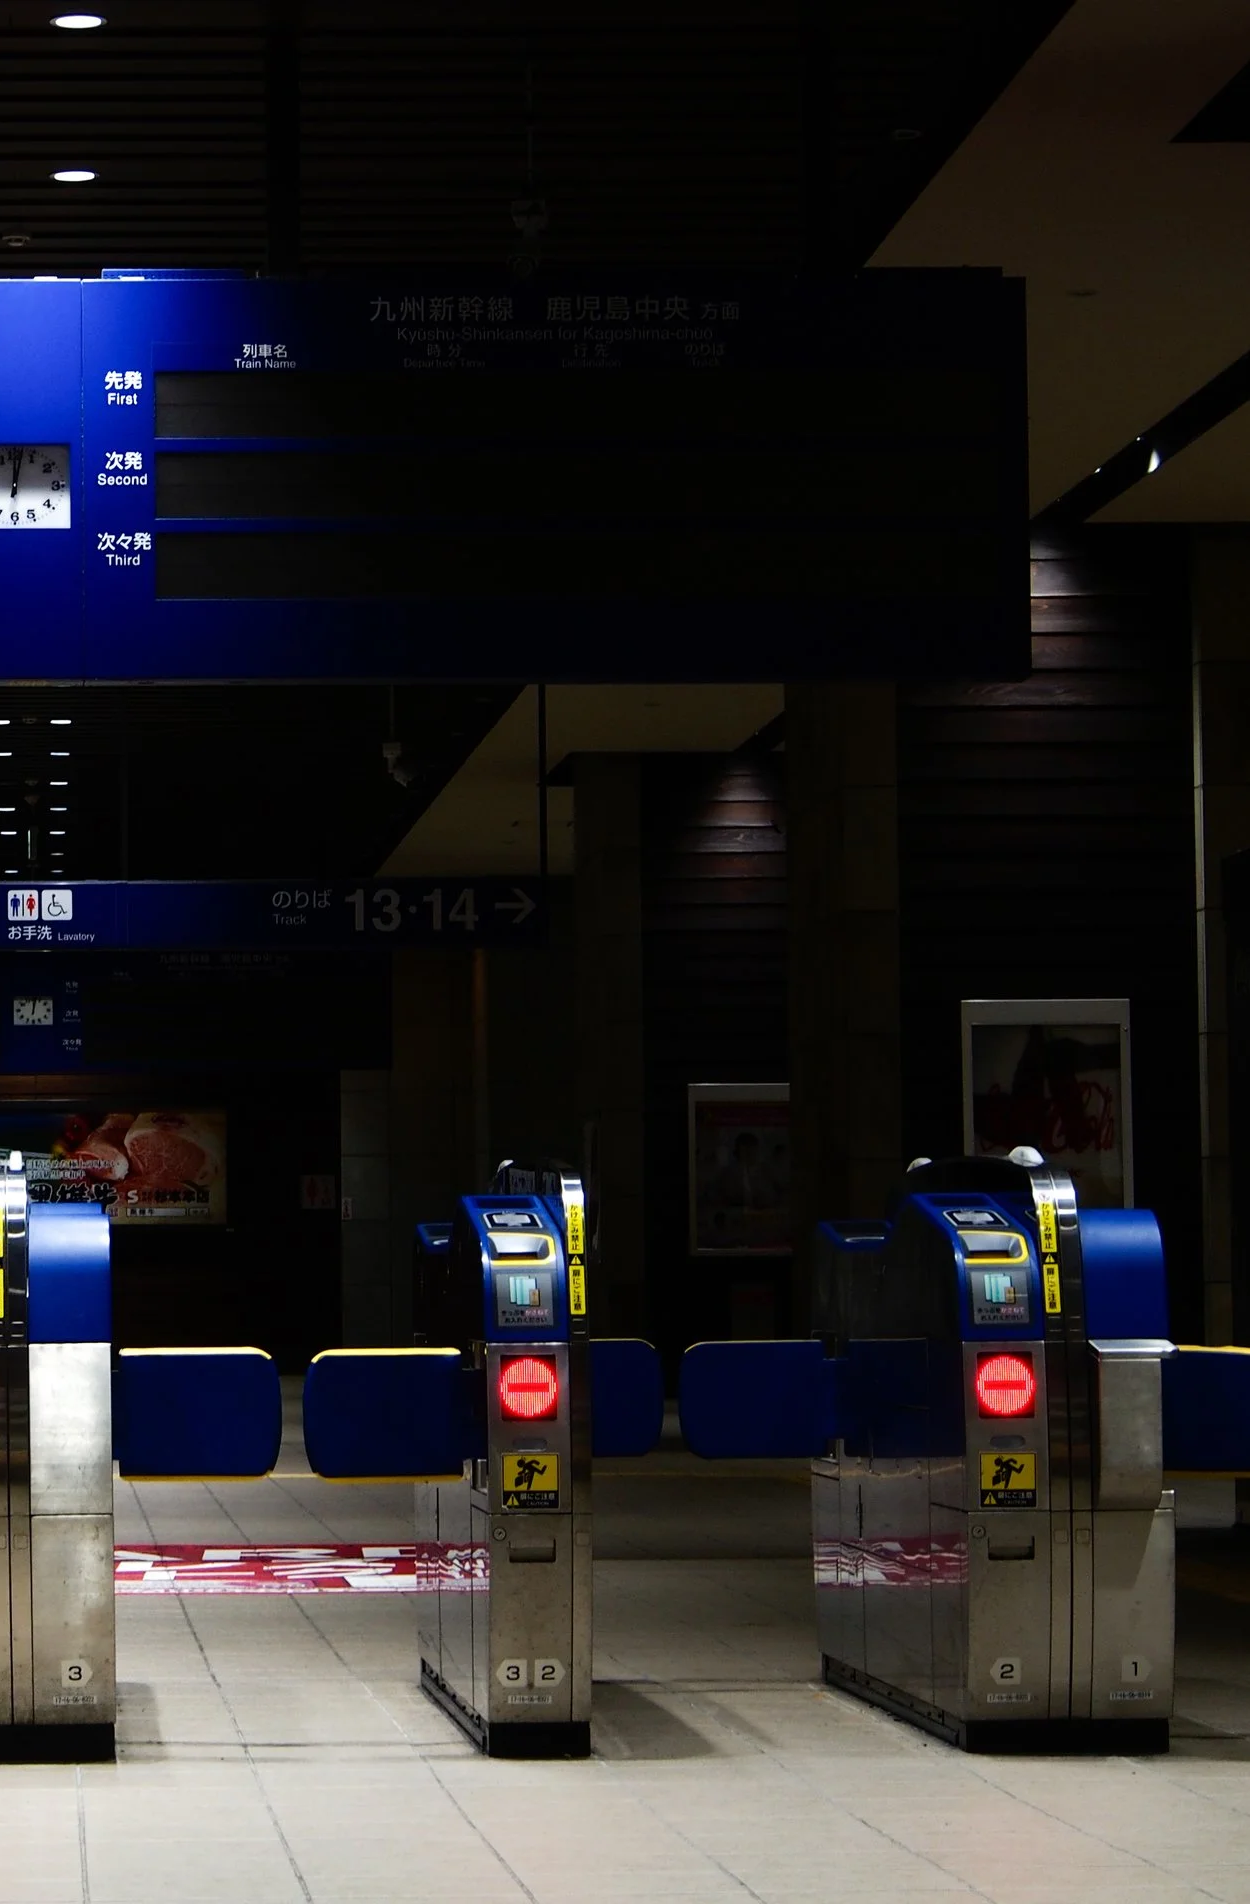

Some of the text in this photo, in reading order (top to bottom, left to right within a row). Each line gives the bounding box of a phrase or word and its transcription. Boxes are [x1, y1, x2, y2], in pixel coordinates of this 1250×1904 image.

[368, 294, 741, 323] 九州新幹線 鹿児島中央 方面
[558, 325, 579, 341] for
[242, 343, 288, 359] 列車名
[234, 358, 297, 369] Train Name
[104, 370, 143, 390] 先発
[107, 393, 138, 405] First
[28, 454, 35, 464] 1
[104, 451, 143, 470] 次発
[42, 462, 52, 474] 2
[51, 480, 61, 491] 3
[97, 473, 148, 486] Second
[42, 498, 52, 509] 4
[10, 511, 20, 522] 6
[26, 509, 36, 519] 5
[96, 532, 152, 551] 次々発
[105, 553, 141, 567] Third
[271, 888, 332, 910] のりば
[271, 912, 307, 926] Track
[7, 924, 96, 943] お手洗 Lavatory
[570, 1203, 580, 1251] かけこみ禁止
[1041, 1203, 1054, 1250] かけこみ禁止
[572, 1269, 582, 1311] 扉にご注意
[1046, 1267, 1057, 1310] 扉にご注意
[68, 1665, 83, 1681] 3
[506, 1665, 520, 1681] 3
[541, 1665, 556, 1681] 2
[1000, 1663, 1015, 1679] 2
[1131, 1661, 1139, 1677] 1
